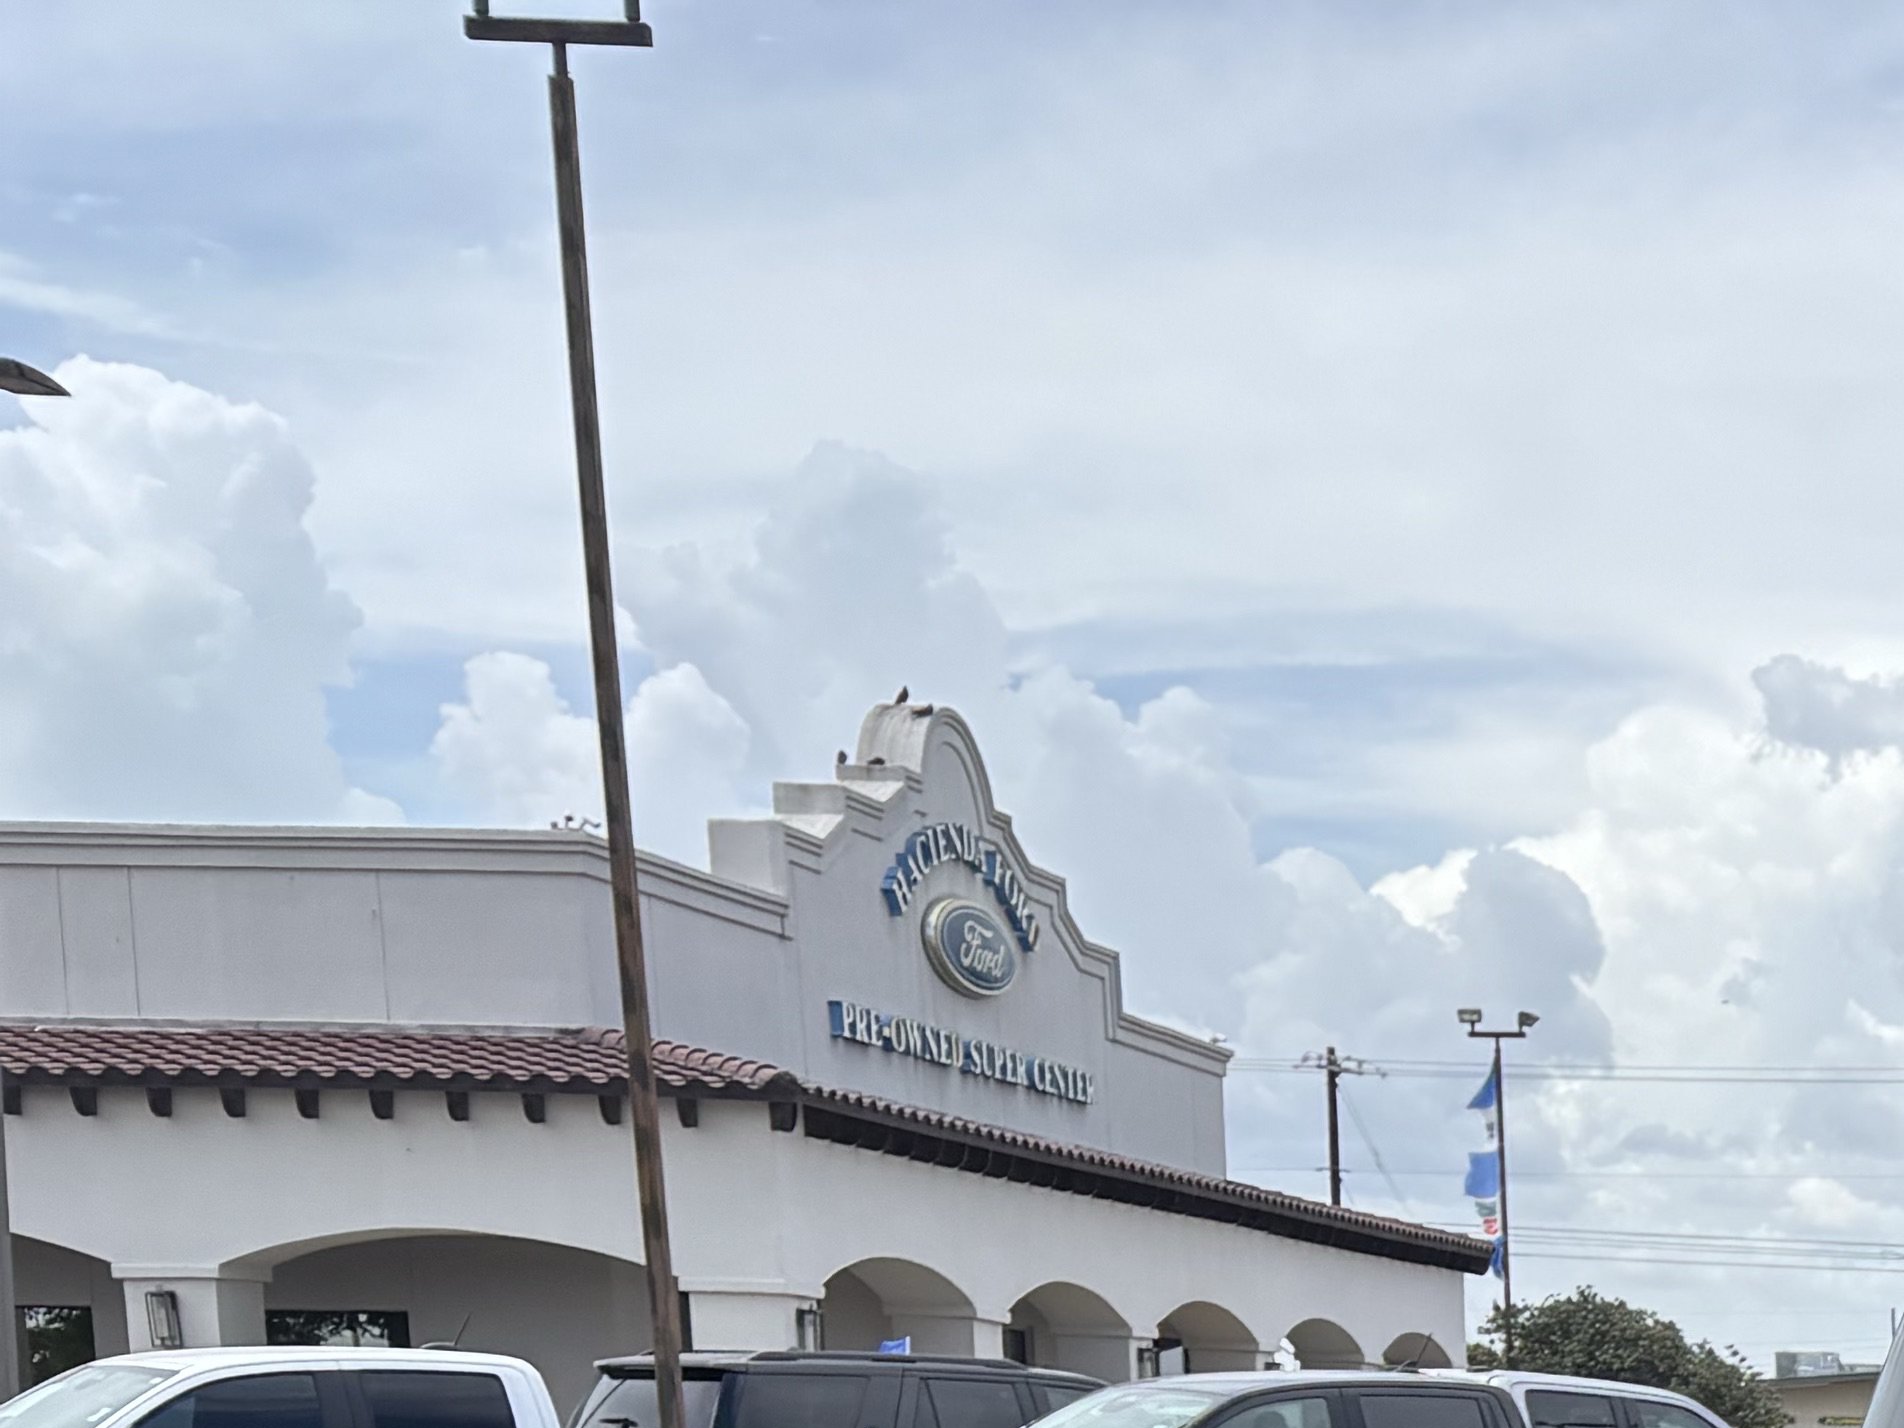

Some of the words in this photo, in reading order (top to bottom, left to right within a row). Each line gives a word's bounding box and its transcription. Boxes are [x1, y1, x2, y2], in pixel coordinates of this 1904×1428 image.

[884, 822, 990, 914] HACIENDA
[986, 850, 1040, 951] FORD
[960, 919, 1007, 978] Ford
[836, 1001, 964, 1068] PRE-OWNED
[968, 1040, 1028, 1088] SUPER
[1033, 1057, 1095, 1105] CENTER
